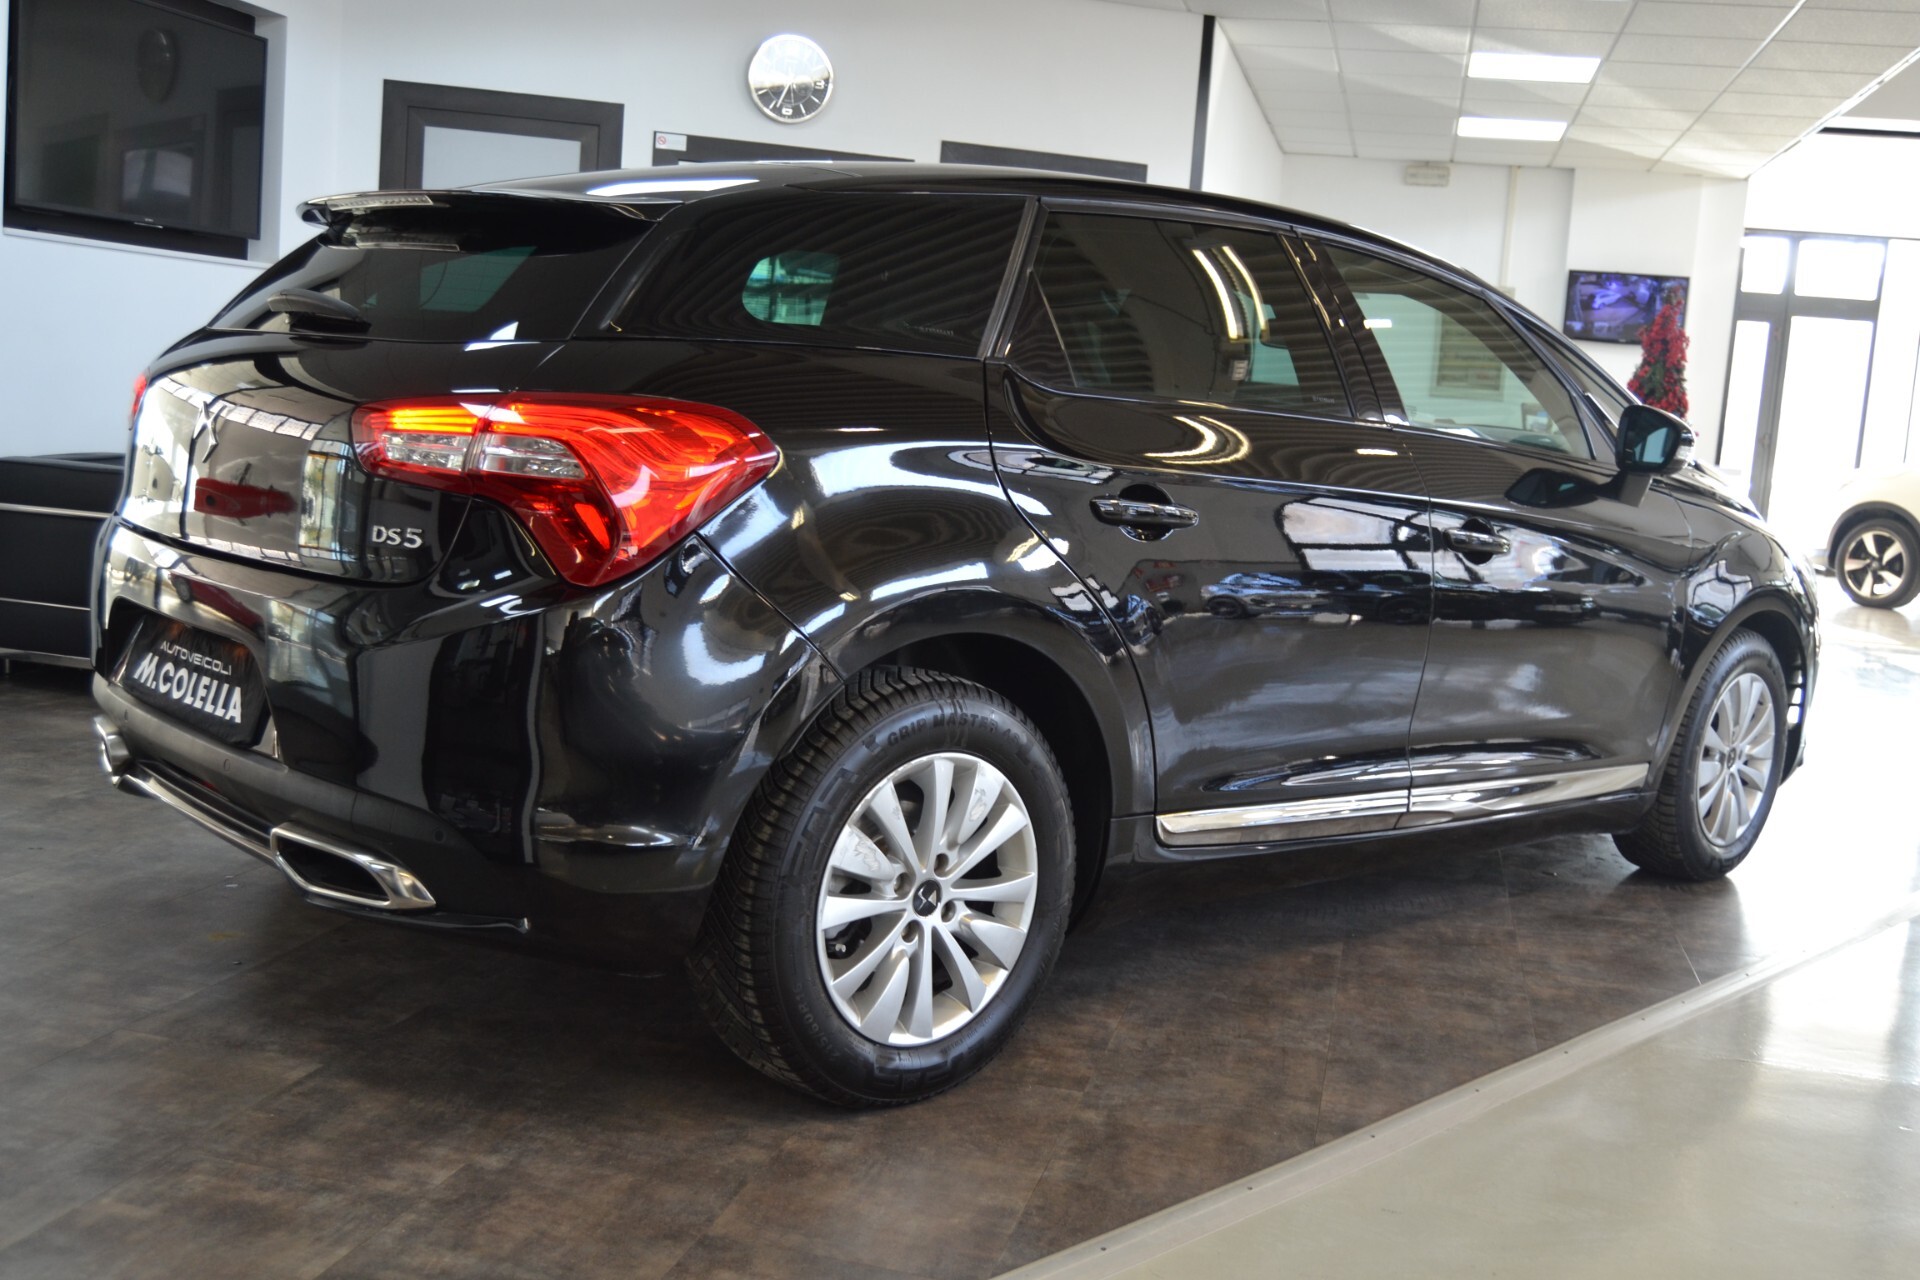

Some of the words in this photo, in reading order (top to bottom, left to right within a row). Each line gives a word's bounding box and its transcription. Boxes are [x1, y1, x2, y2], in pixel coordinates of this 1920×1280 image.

[815, 80, 825, 89] 3
[160, 641, 232, 675] AUTOVEICOLI
[133, 652, 242, 723] M.COLELLA
[887, 718, 927, 747] GRIP
[932, 712, 999, 733] MASTER
